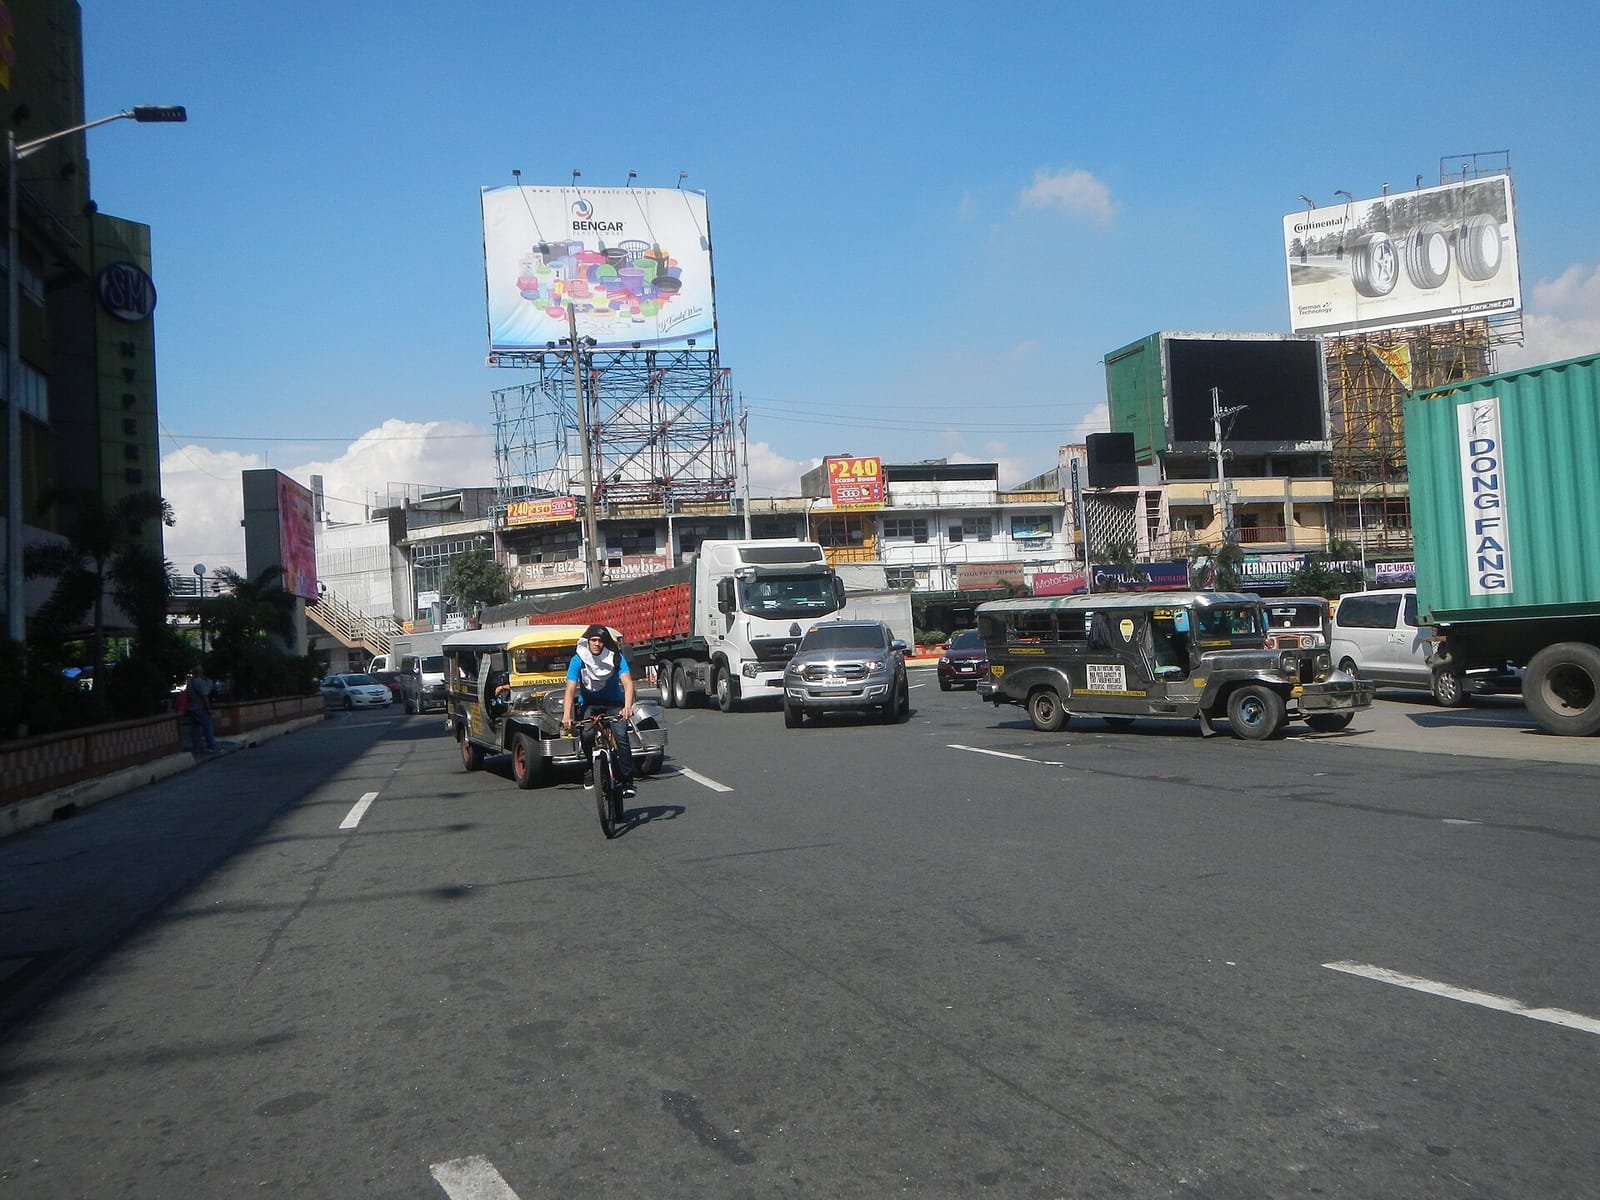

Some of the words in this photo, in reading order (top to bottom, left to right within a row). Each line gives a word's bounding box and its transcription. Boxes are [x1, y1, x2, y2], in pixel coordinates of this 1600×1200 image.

[572, 220, 624, 231] BENGAR
[1294, 217, 1343, 233] Continental
[107, 266, 148, 314] SM
[1299, 308, 1332, 316] Technology
[1469, 438, 1500, 511] DONG
[1071, 460, 1081, 527] CEBUANA
[1475, 517, 1506, 590] FANG
[959, 570, 993, 578] POULTRY
[994, 568, 1022, 576] SUPPLY
[1095, 571, 1153, 587] CEBUAA
